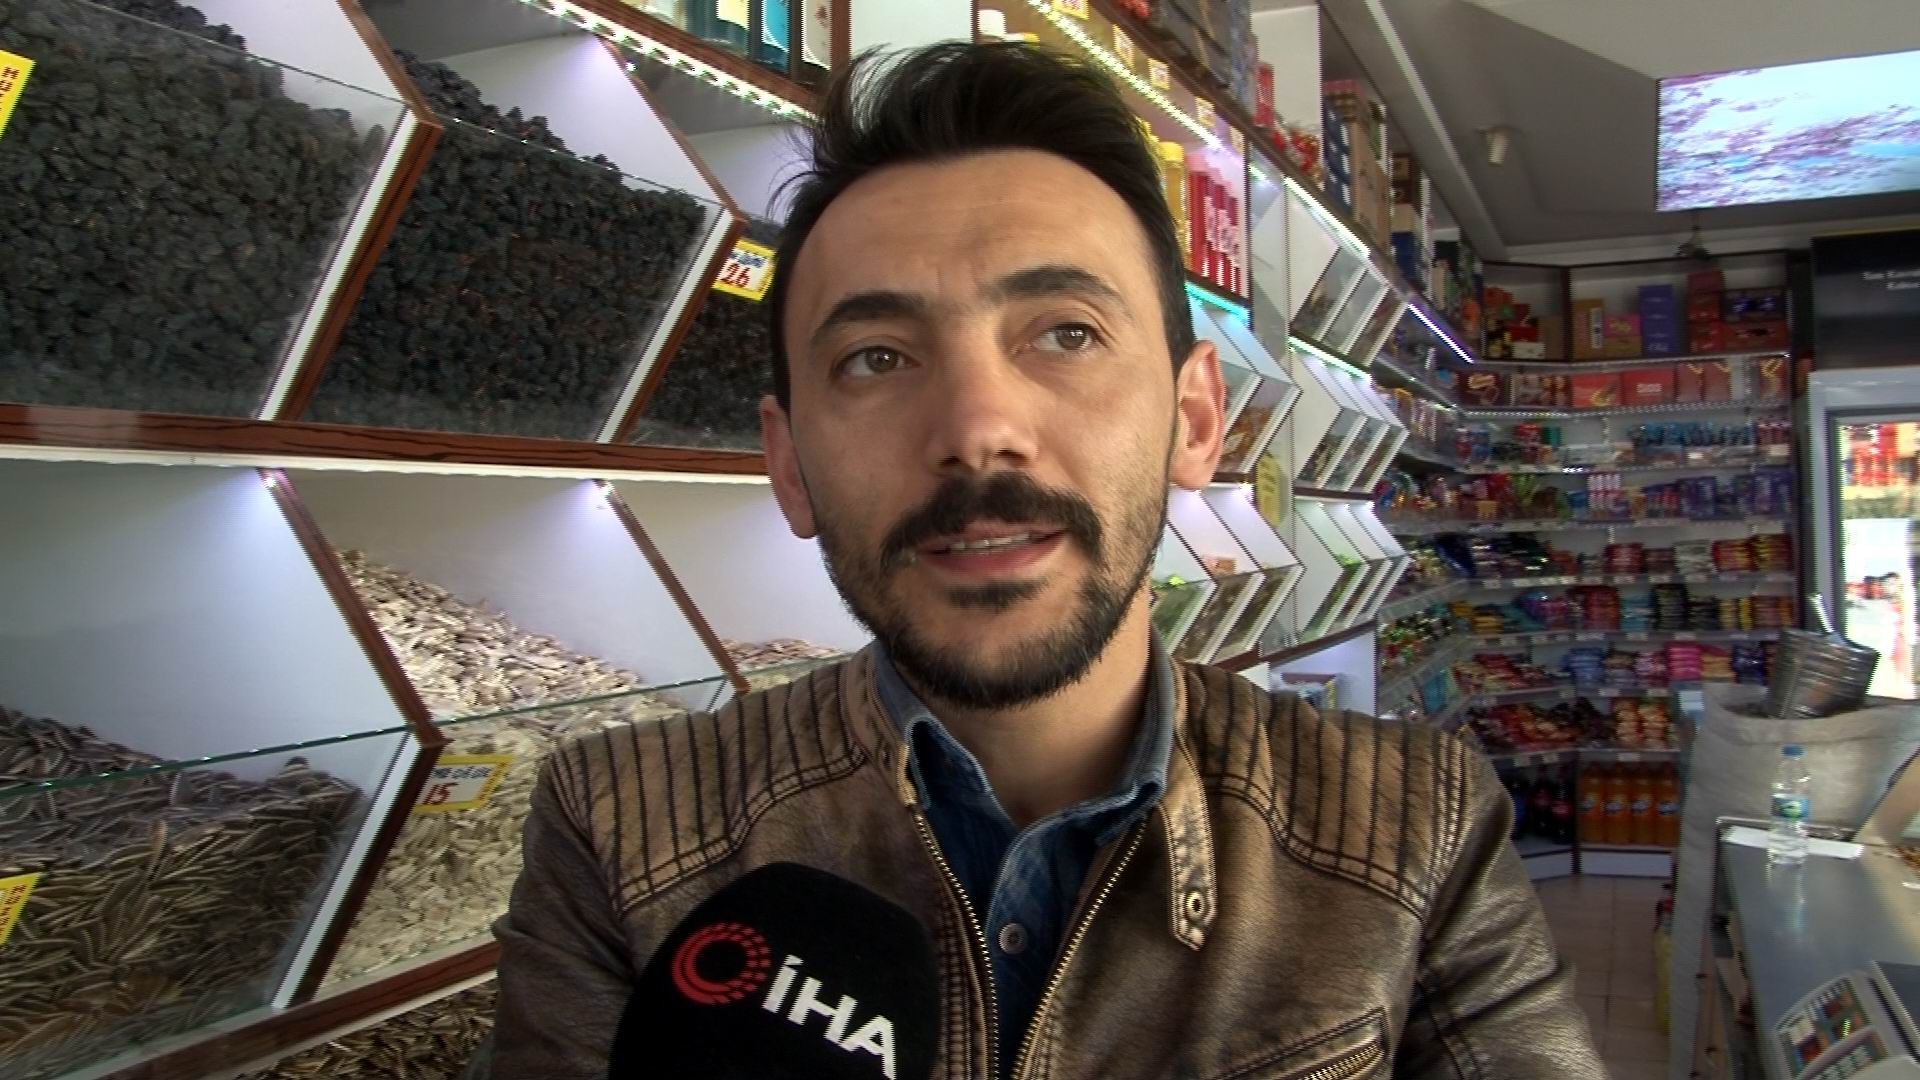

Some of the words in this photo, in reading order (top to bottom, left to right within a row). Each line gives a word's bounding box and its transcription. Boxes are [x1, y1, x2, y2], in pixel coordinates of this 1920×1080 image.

[720, 263, 751, 288] 26
[422, 782, 459, 805] 15
[762, 954, 897, 1080] İHA
